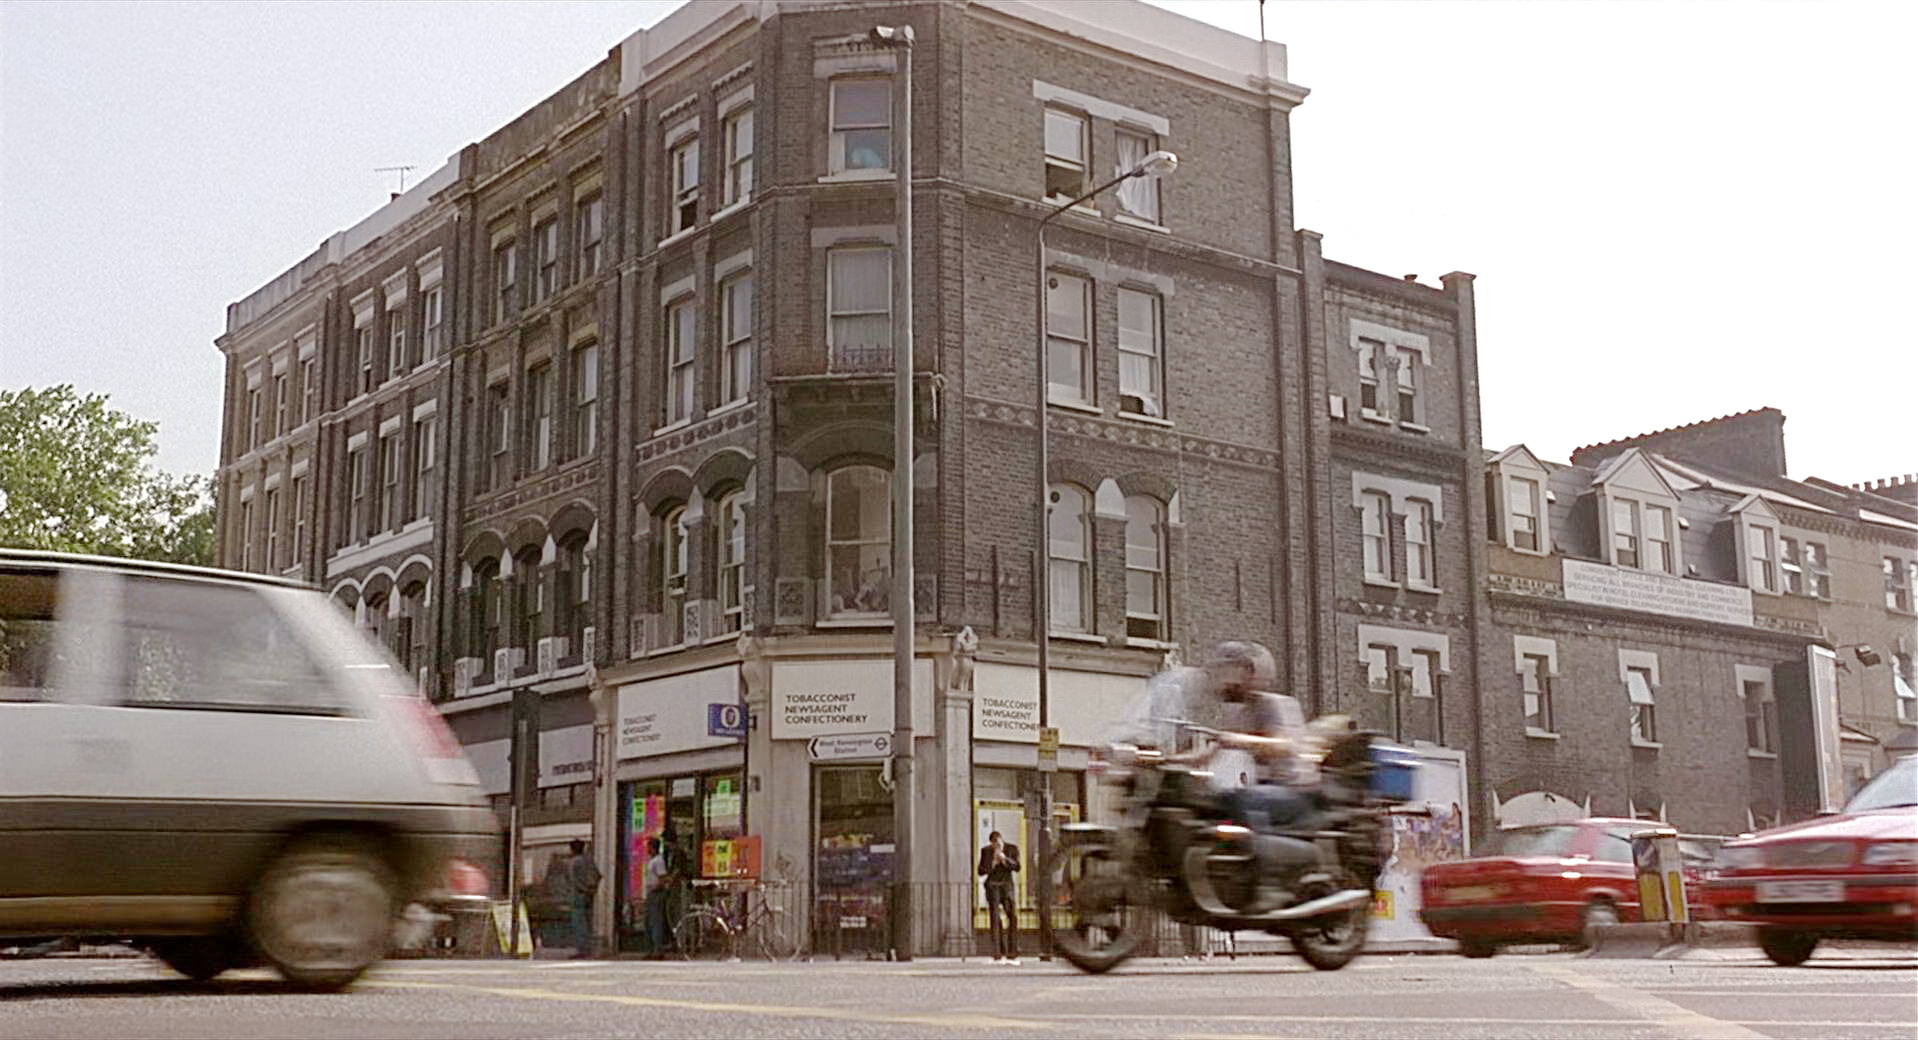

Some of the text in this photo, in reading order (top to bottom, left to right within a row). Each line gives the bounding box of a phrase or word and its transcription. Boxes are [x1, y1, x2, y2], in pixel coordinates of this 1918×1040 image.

[785, 694, 856, 703] TOBACCONIST
[785, 704, 848, 714] NEWSAGENT
[983, 698, 1037, 710] TOBACCONIST
[982, 709, 1031, 720] NEWSAGENT
[785, 715, 868, 725] CONFECTIONERY
